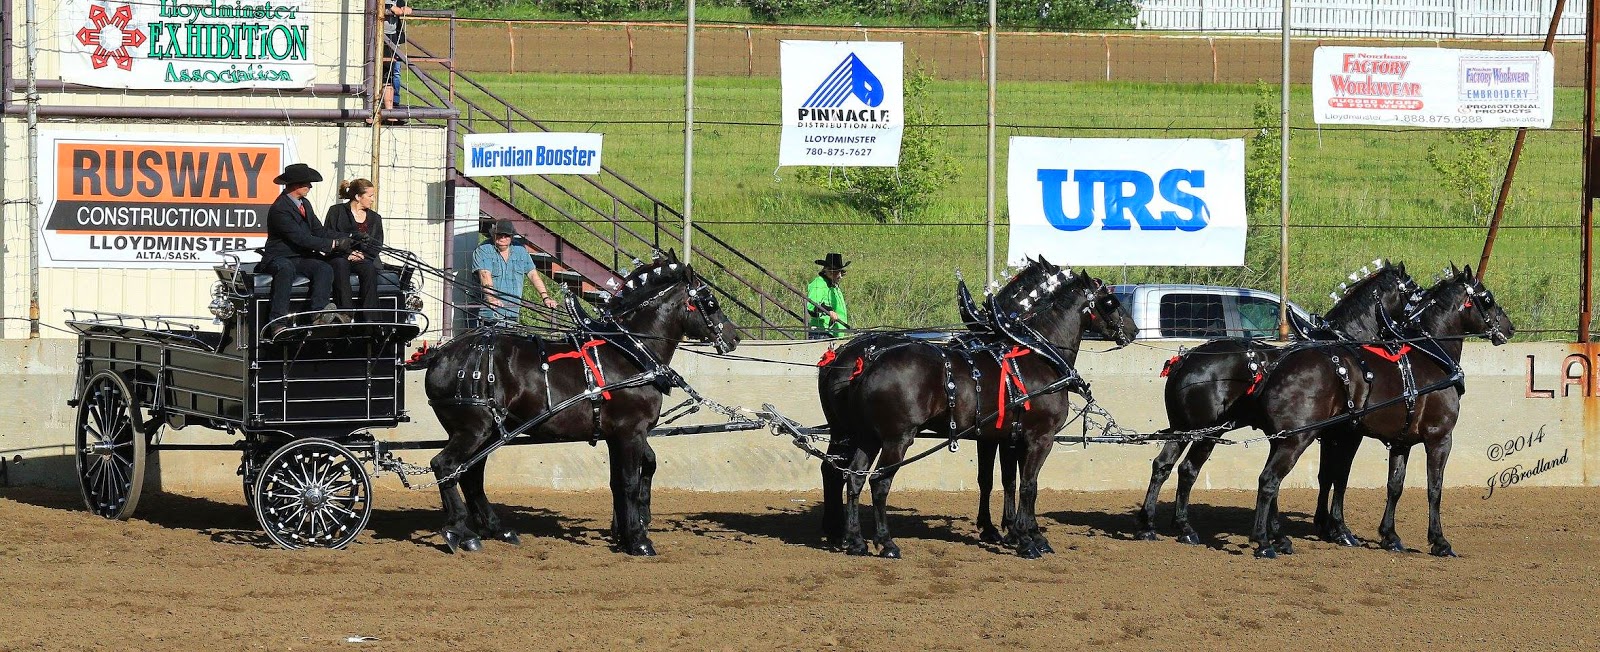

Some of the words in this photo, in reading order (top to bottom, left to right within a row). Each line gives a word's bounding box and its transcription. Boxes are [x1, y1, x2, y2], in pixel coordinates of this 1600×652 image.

[159, 0, 299, 24] Lloydminster
[148, 21, 309, 60] EXHIBITION
[165, 62, 293, 83] Association
[1467, 90, 1529, 99] EMBROIDERY
[798, 108, 890, 122] PINNACLE
[804, 135, 877, 144] LLOYDMINSTER
[471, 146, 533, 168] Meridian
[536, 145, 596, 167] Booster
[806, 147, 873, 157] 780-875-7627
[73, 149, 268, 198] RUSWAY
[1037, 168, 1211, 232] URS
[77, 206, 221, 228] CONSTRUCTION
[225, 209, 262, 228] LTD.
[90, 235, 248, 252] LLOYDMINSTER
[135, 251, 200, 260] ALTA./SASK.
